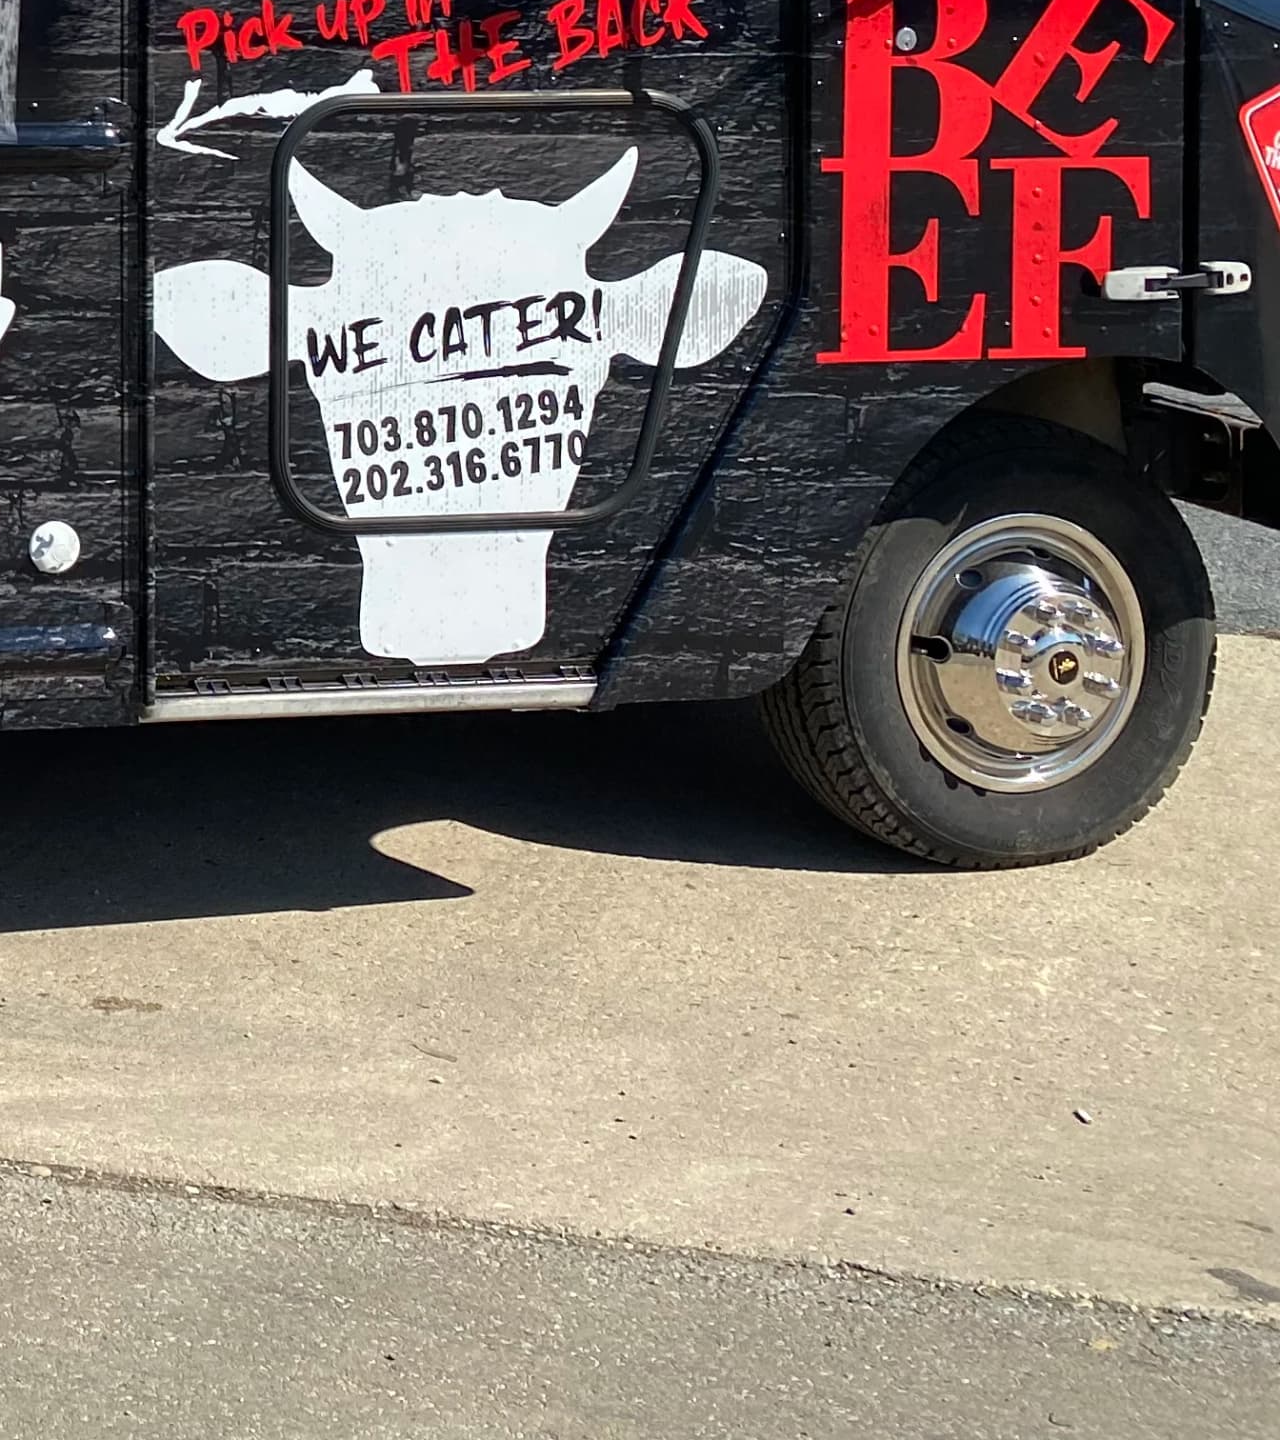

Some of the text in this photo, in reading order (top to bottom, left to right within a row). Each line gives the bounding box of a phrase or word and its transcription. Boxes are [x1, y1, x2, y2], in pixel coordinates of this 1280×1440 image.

[372, 10, 532, 94] THE
[306, 290, 604, 377] WE CATER!
[334, 384, 583, 460] 703.870.1294
[342, 429, 588, 504] 202.316.6770
